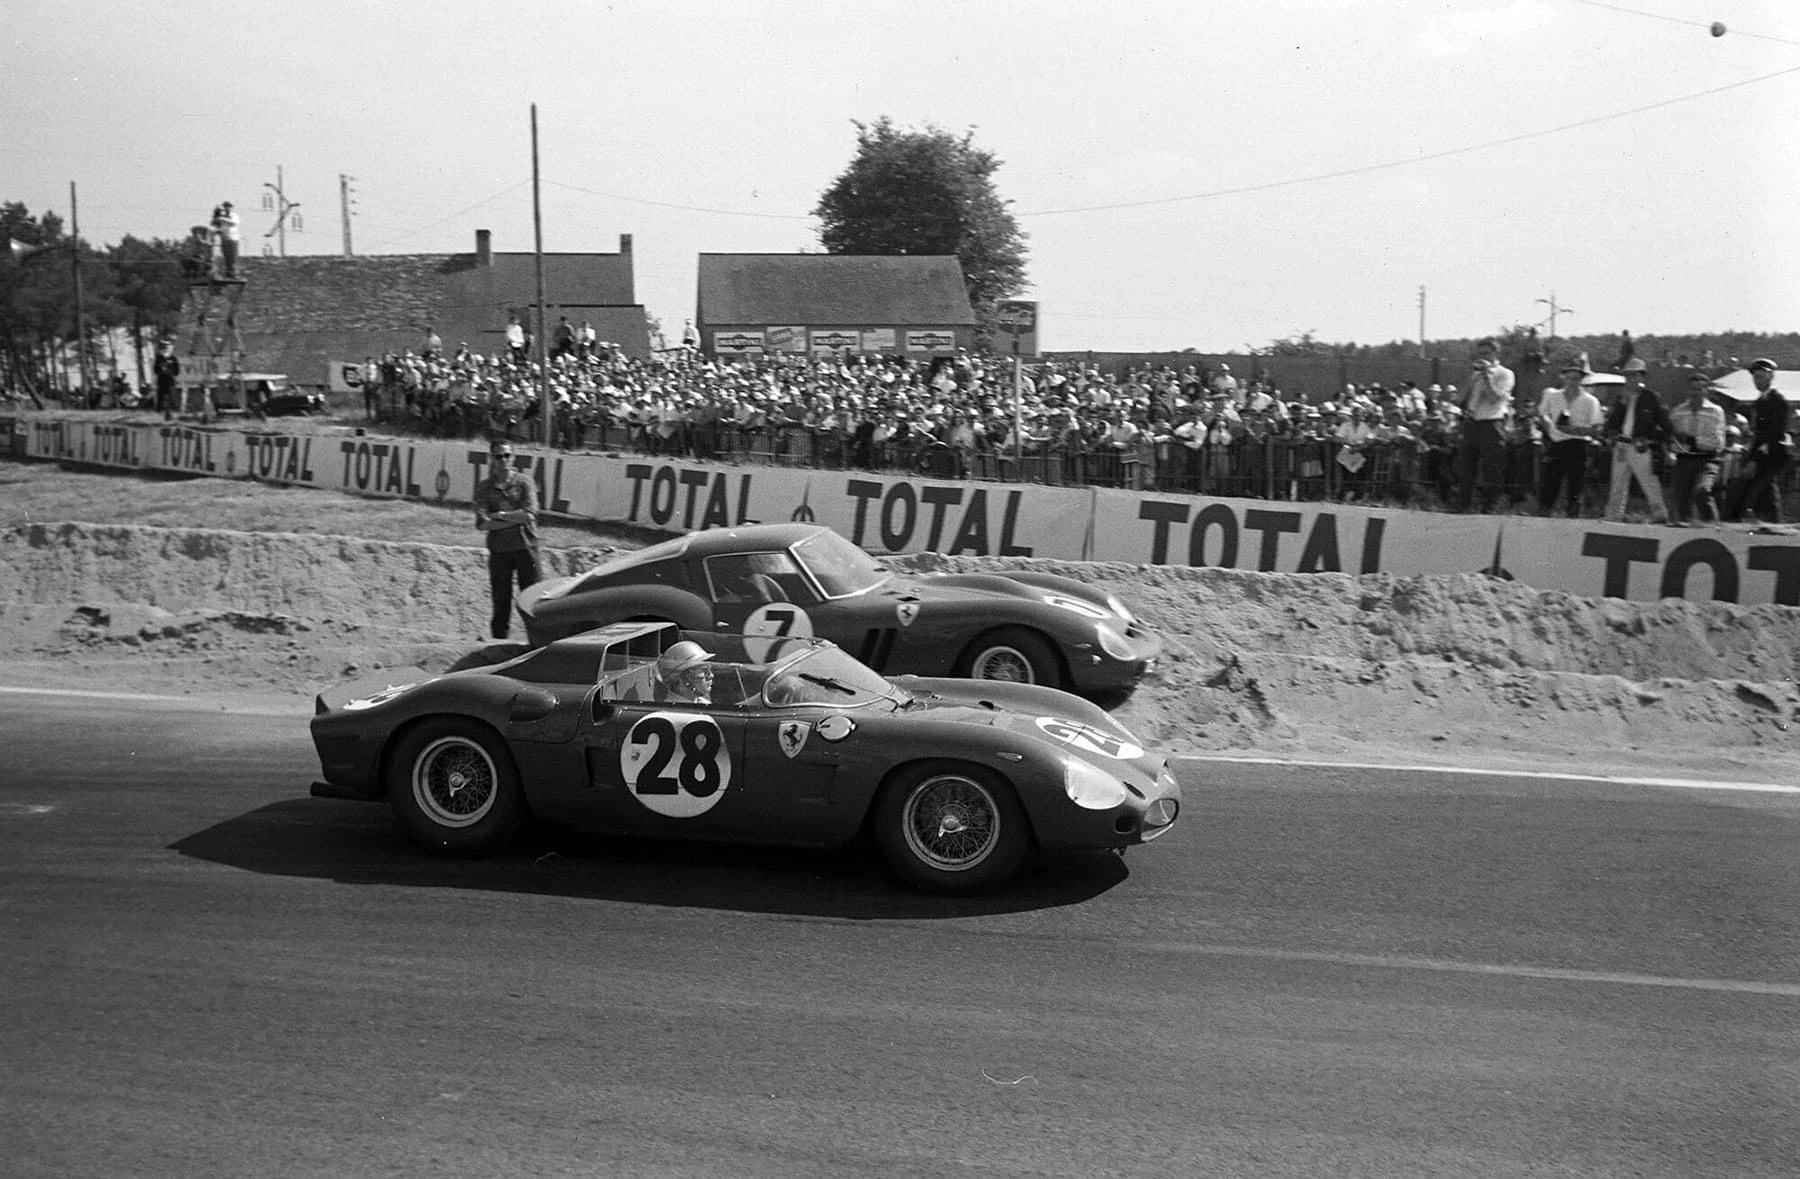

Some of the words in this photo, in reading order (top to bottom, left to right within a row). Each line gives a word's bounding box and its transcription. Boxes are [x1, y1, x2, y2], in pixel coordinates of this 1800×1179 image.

[160, 428, 215, 471] TOTAL
[246, 436, 313, 481] TOTAL
[341, 441, 420, 496] TOTAL
[468, 451, 571, 513] TTAL
[626, 464, 761, 530] TOTAL
[847, 479, 1033, 557] TOTAL
[762, 610, 794, 664] 7
[631, 716, 721, 798] 28
